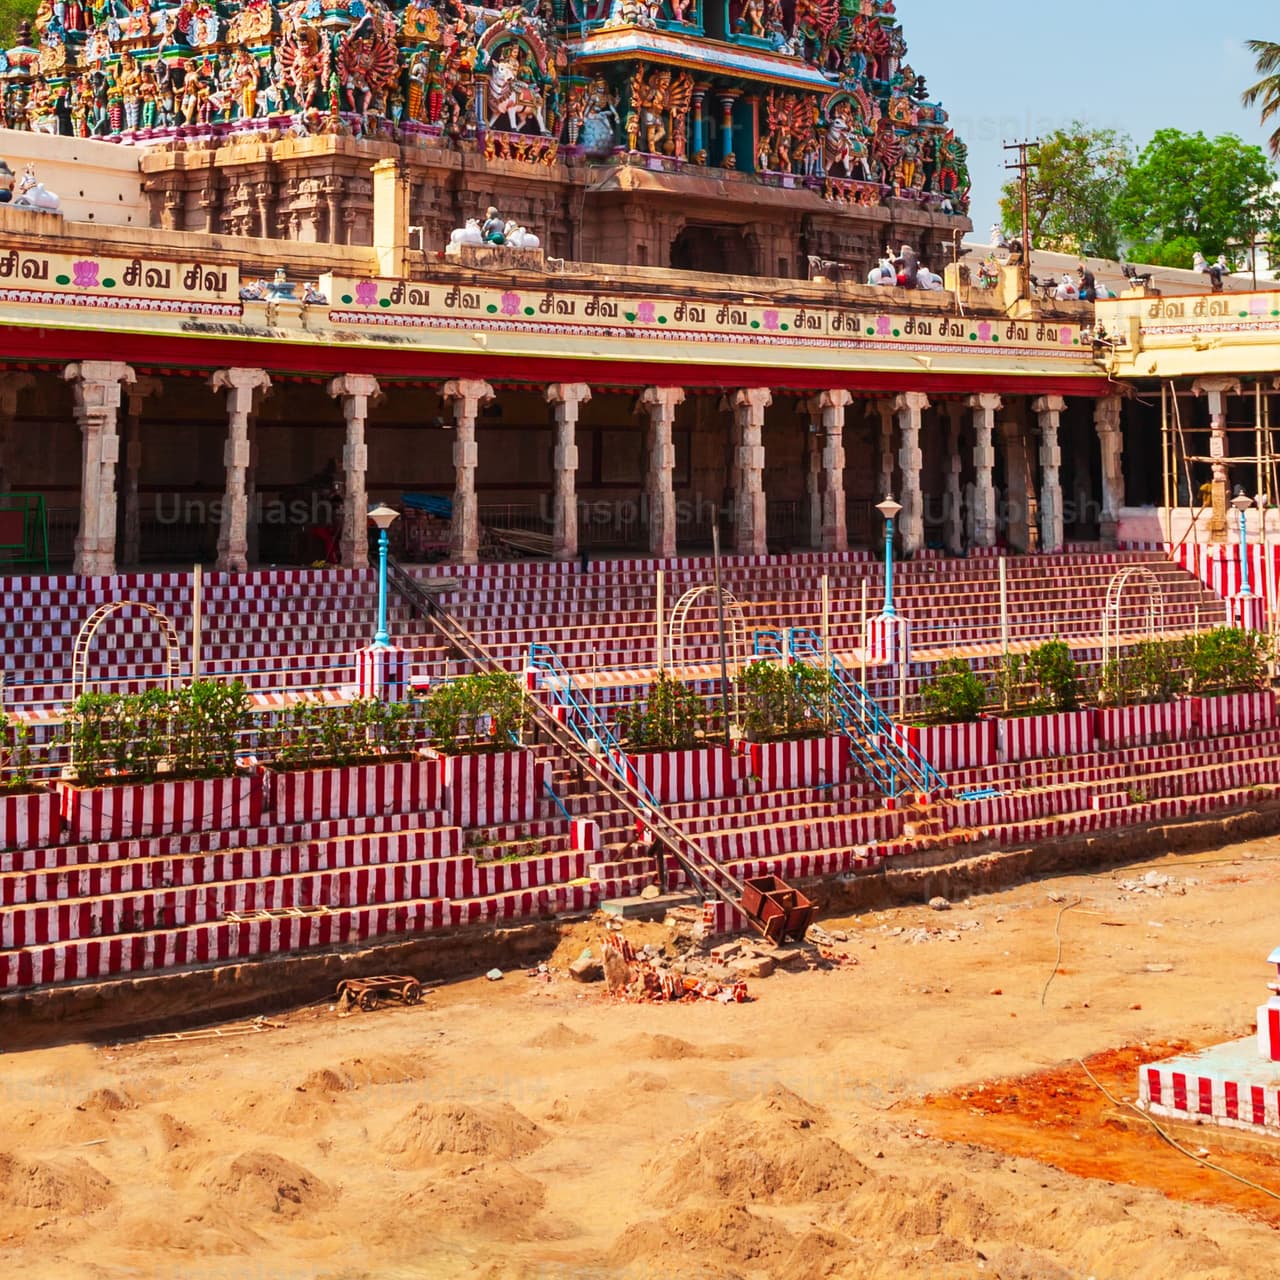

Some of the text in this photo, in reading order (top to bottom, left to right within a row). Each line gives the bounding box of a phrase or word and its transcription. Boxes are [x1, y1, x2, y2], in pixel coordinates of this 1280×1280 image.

[122, 259, 227, 292] சிவ சிவ
[389, 280, 480, 310] சிவ சிவ
[539, 293, 618, 318] சிவ சிவ
[673, 302, 747, 325] சிவ சிவ
